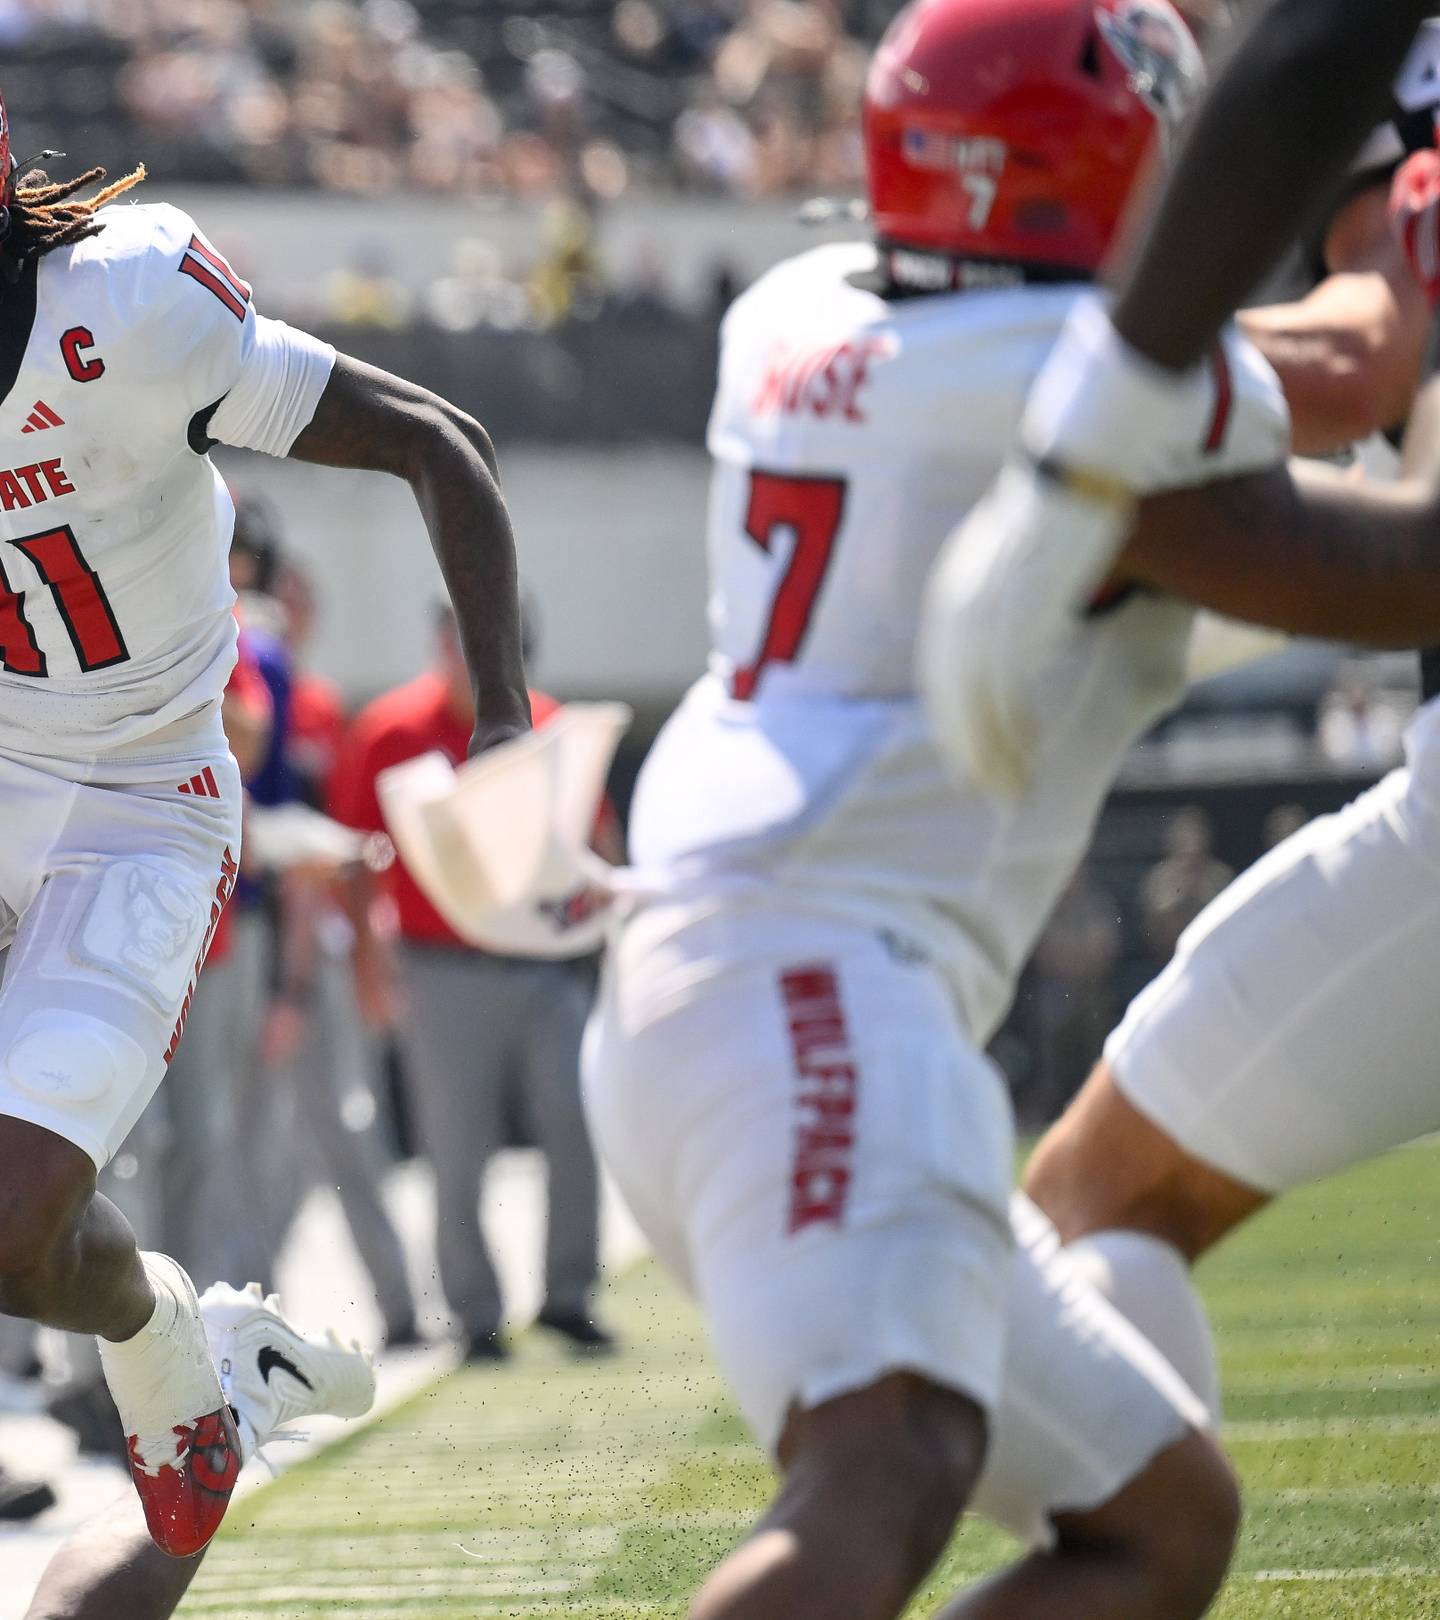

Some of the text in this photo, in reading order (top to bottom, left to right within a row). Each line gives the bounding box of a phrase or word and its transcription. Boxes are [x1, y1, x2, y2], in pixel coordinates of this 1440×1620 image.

[964, 174, 997, 232] 7
[178, 232, 251, 324] 11
[59, 325, 105, 383] C
[731, 467, 849, 701] 7
